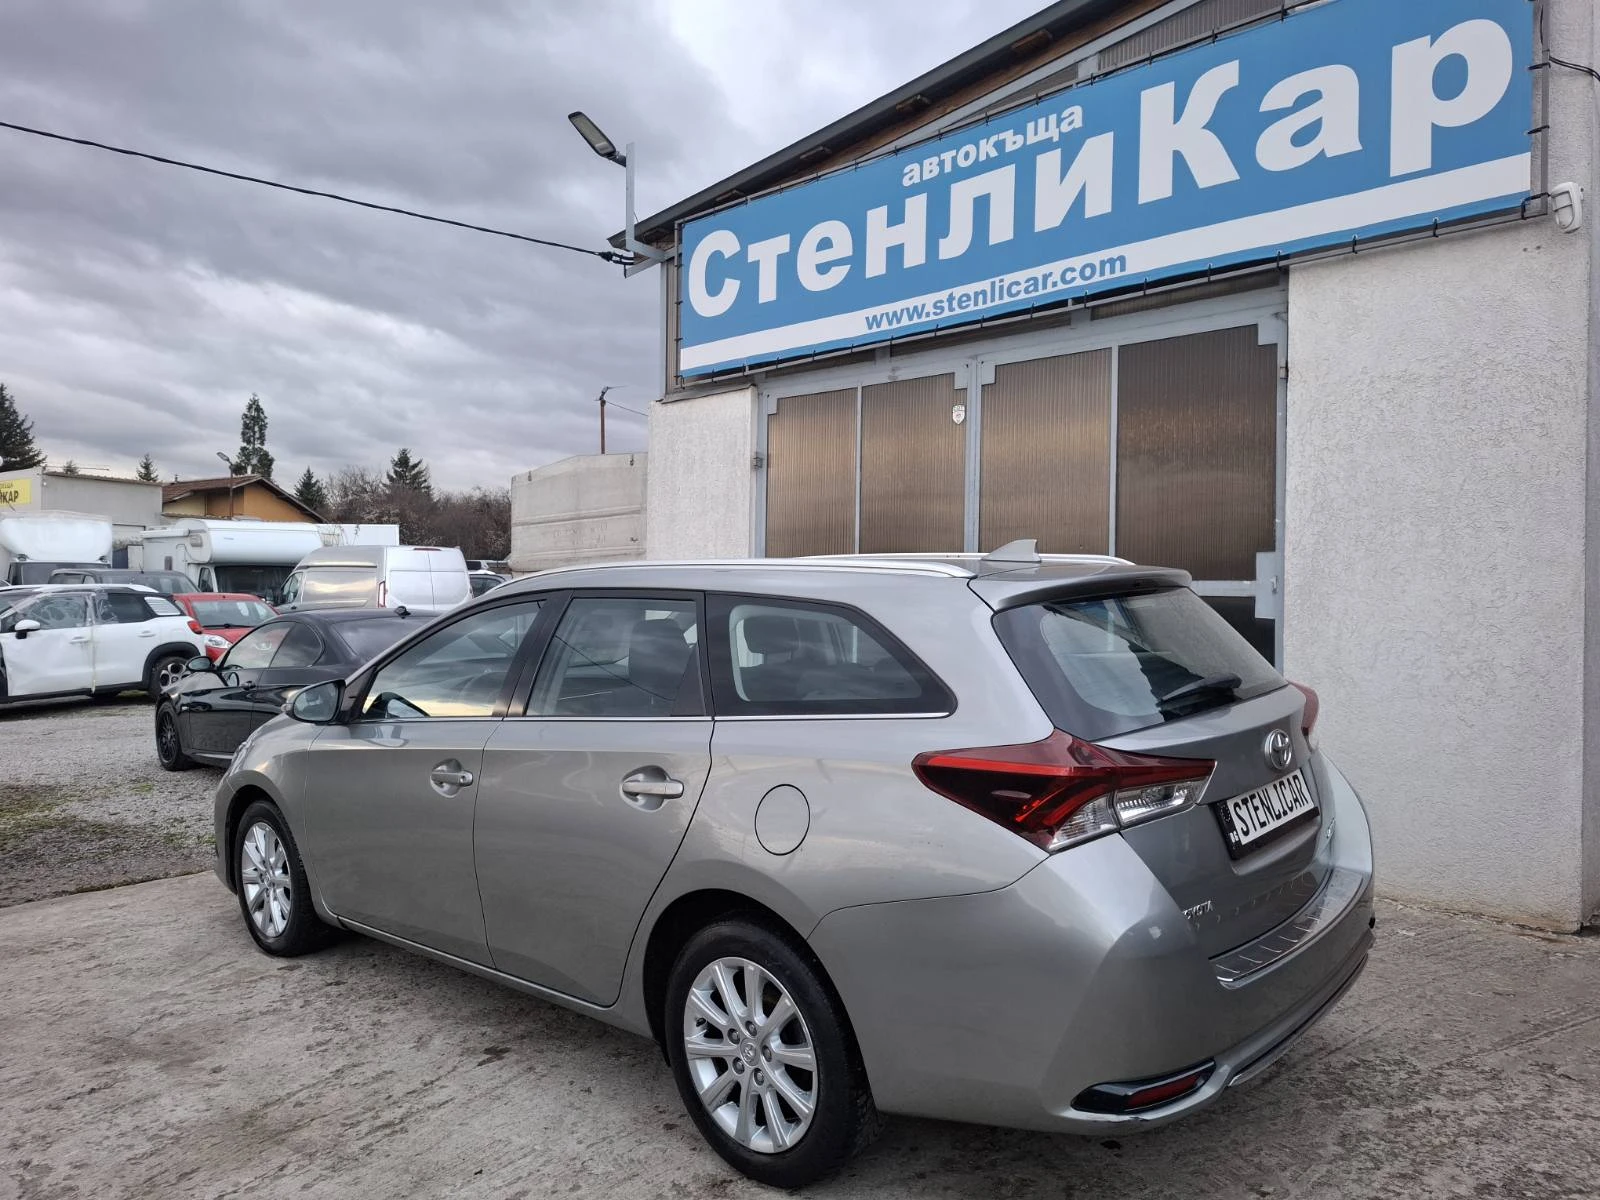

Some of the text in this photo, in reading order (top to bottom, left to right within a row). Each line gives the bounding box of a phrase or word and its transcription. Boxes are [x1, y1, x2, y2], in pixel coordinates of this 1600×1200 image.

[688, 19, 1512, 318] СтенлиКар
[902, 105, 1083, 187] автокъща
[865, 254, 1127, 330] www.stenlicar.com
[1233, 774, 1308, 837] STENLICAR
